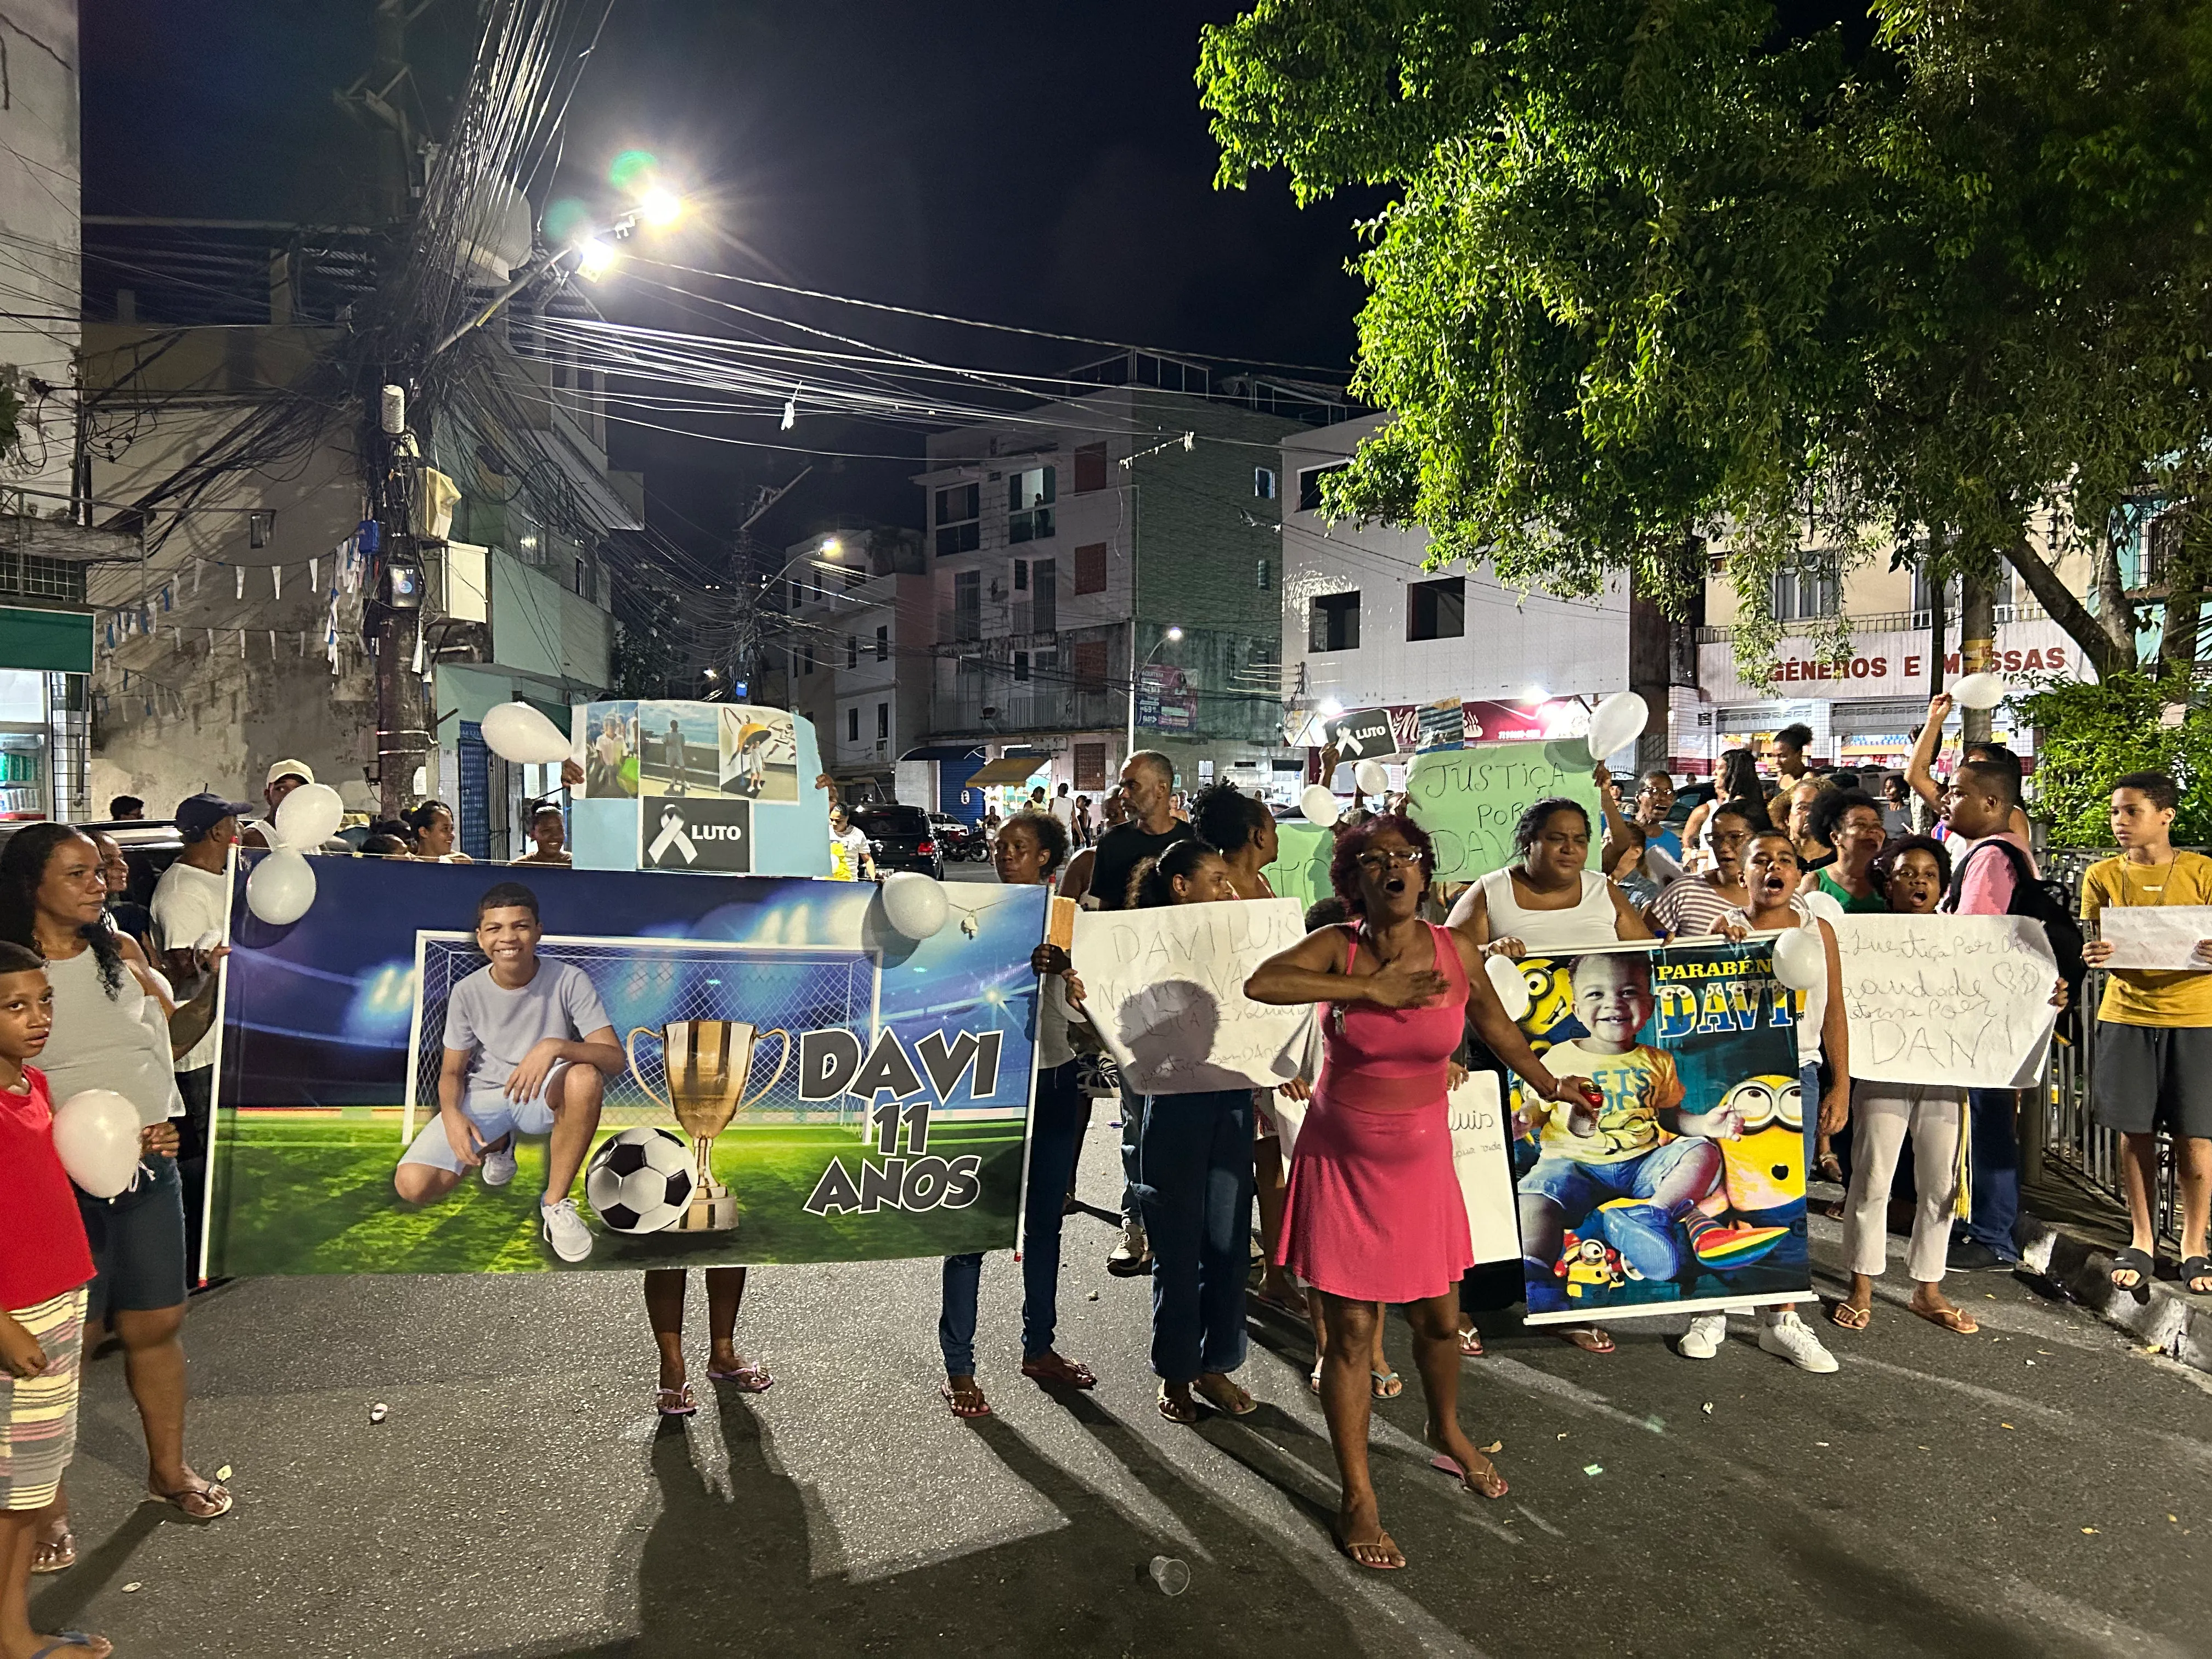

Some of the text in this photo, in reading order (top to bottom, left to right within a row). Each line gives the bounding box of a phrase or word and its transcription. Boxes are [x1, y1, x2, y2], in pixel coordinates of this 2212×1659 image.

[1768, 647, 2065, 682] GÊNEROS E MSSAS
[1355, 725, 1386, 740] LUTO
[691, 825, 742, 840] LUTO
[1477, 802, 1524, 829] POR
[1427, 829, 1519, 875] DAV
[1111, 921, 1216, 966] DAVI
[1657, 955, 1772, 981] PARABÉN
[1655, 979, 1793, 1039] DAVI
[798, 1025, 1004, 1107] DAVI
[1592, 1066, 1651, 1093] ET'S
[871, 1101, 933, 1156] 11
[802, 1155, 982, 1216] ANOS
